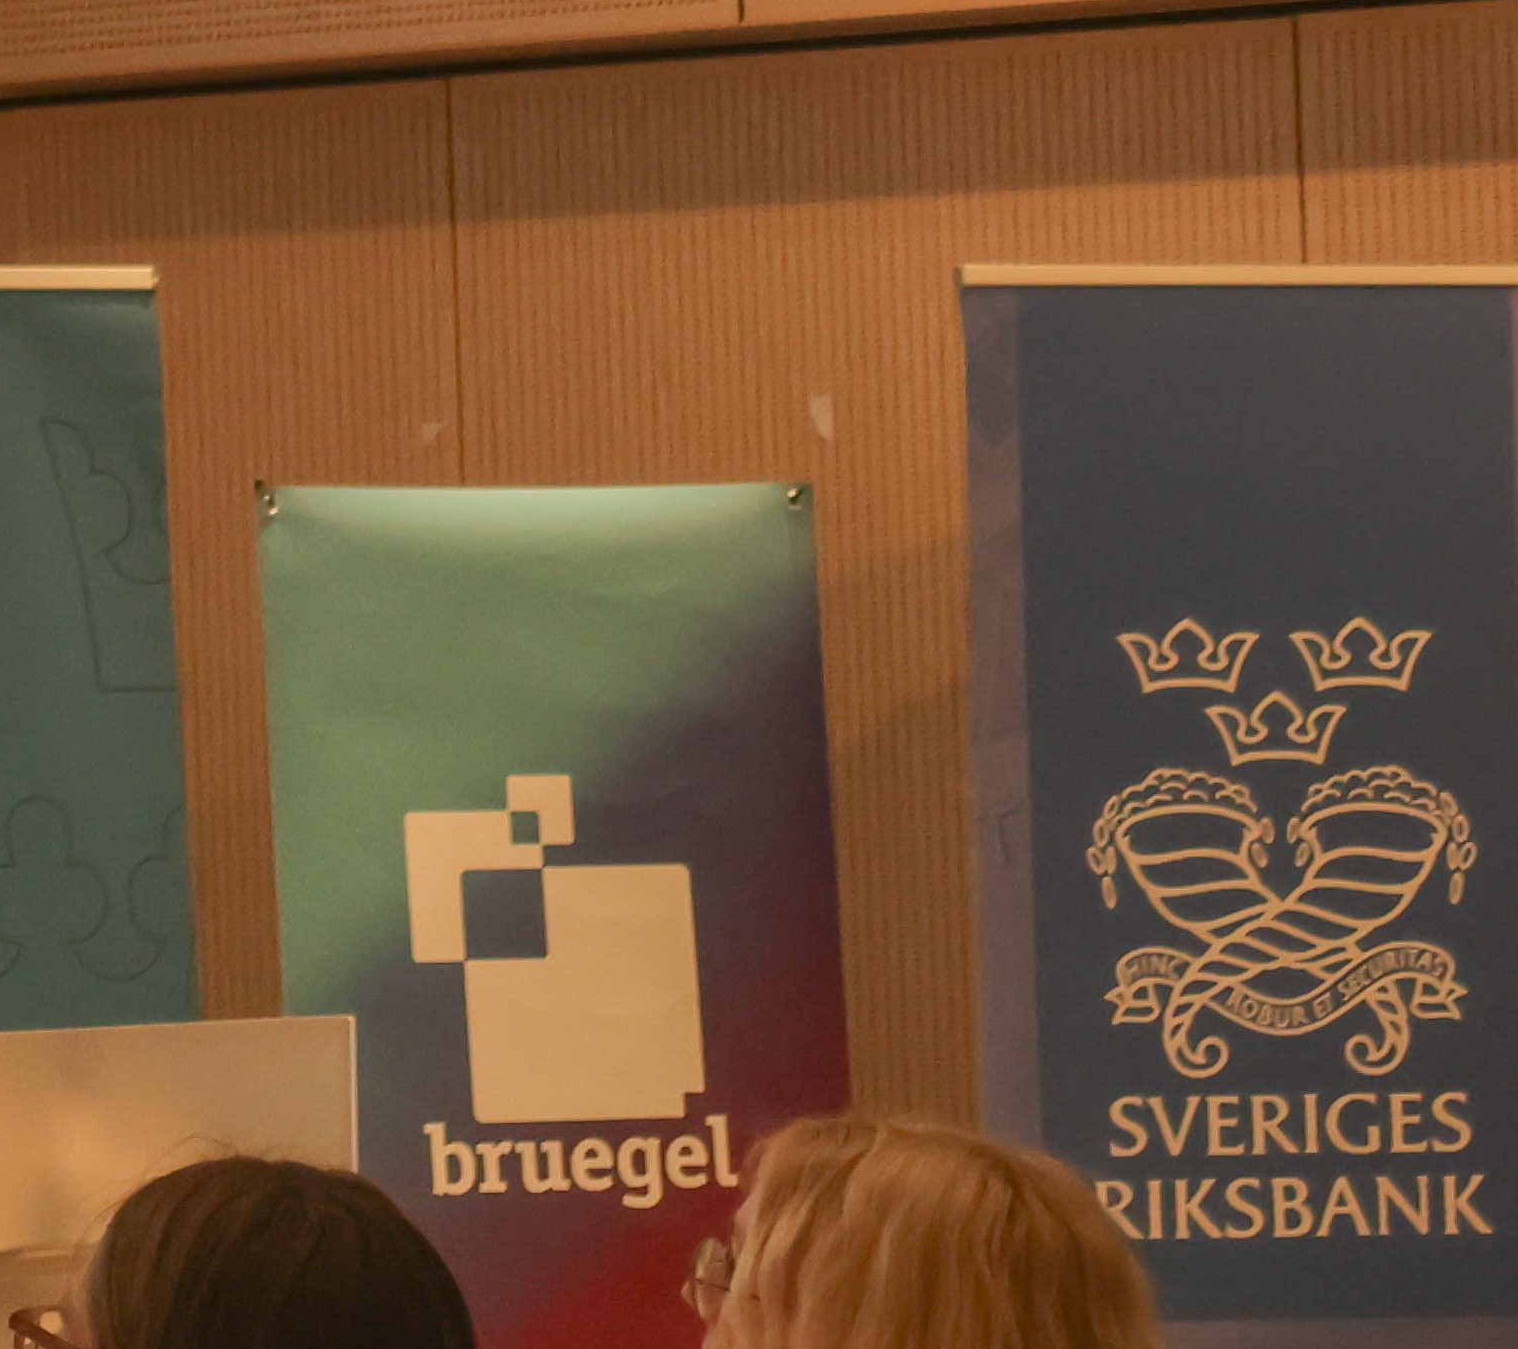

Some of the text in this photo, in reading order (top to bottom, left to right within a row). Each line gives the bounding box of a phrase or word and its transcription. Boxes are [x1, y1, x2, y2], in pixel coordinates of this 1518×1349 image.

[1108, 1091, 1475, 1158] SVERIGES
[422, 1113, 740, 1210] bruegel
[1094, 1173, 1495, 1241] RIKSBANK
